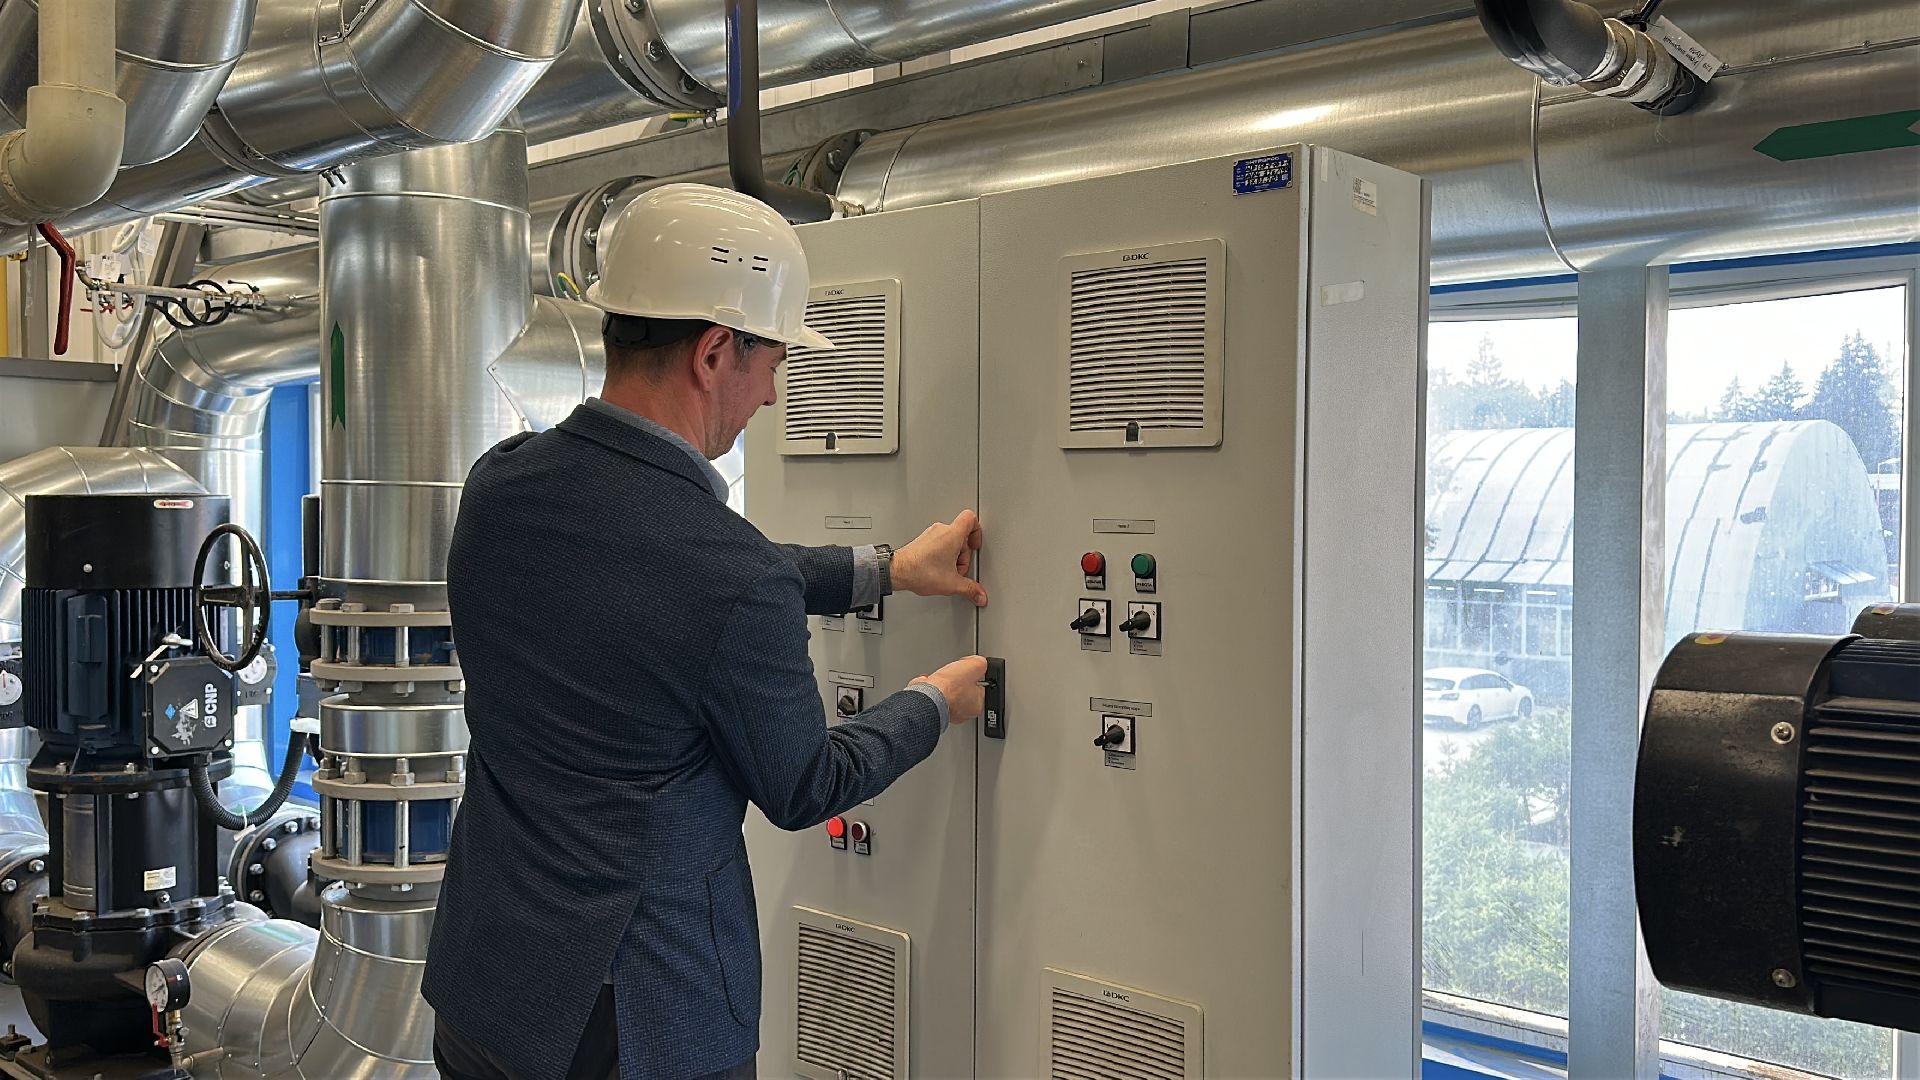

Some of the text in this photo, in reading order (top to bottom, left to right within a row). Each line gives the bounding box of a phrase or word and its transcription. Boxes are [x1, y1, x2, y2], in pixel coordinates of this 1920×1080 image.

[1131, 252, 1149, 261] DKC
[205, 683, 218, 714] CNP
[1111, 992, 1129, 1002] DKC
